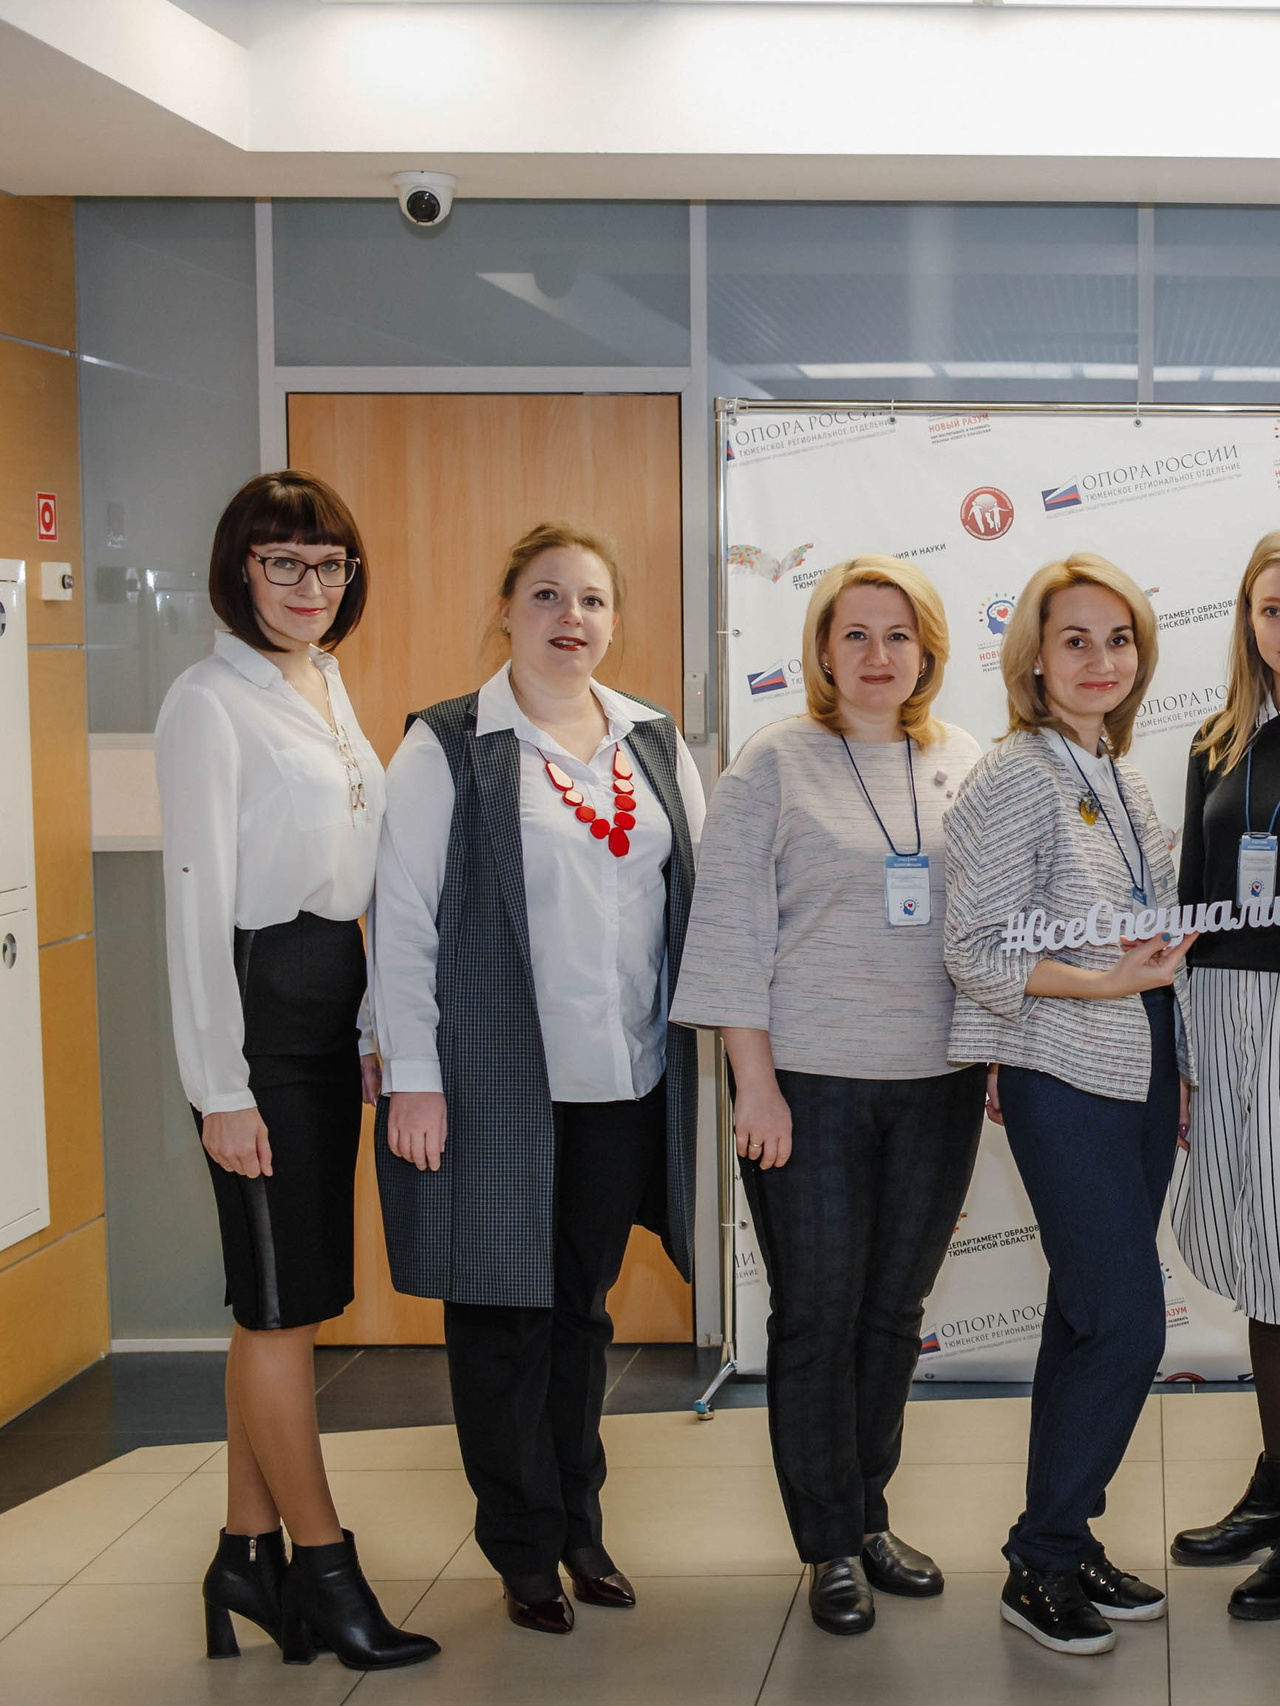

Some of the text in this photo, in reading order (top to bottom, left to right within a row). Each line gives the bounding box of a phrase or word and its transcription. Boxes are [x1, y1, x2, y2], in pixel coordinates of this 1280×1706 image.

[735, 420, 805, 446] ОПОРА
[928, 420, 960, 433] НОВЫЙ
[962, 413, 990, 426] РАЗУМ
[738, 420, 891, 457] ТЮМЕНСКОЕ РЕГИОНАЛЬНОЕ ОТДЕЛЕНИ
[1082, 464, 1152, 491] ОПОРА
[1154, 444, 1239, 475] РОССИИ
[1086, 462, 1241, 502] ТЮМЕНСКОЕ РЕГИОНАЛЬНОЕ ОТДЕЛЕНИЕ
[919, 543, 947, 555] НАУКИ
[1158, 599, 1236, 621] РТАМЕНТ ОБРАЗОВ
[1158, 609, 1230, 631] ЕНСКОЙ ОБЛАСТИ
[1135, 691, 1201, 718] ОПОРА
[1135, 713, 1182, 730] ТЮМЕНСКОЕ
[1184, 704, 1226, 719] РЕГИОНАЛ
[948, 1224, 1040, 1250] ДЕПАРТАМЕНТ ОБРАЗОВ
[948, 1233, 1036, 1258] ТЮМЕНСКОЙ ОБЛАСТИ
[941, 1302, 1047, 1338] ОПОРА РОС
[1166, 1306, 1188, 1317] АЗУМ
[944, 1333, 989, 1349] ТЮМЕНСКОЕ
[991, 1322, 1043, 1339] РЕГИОНАЛЬН
